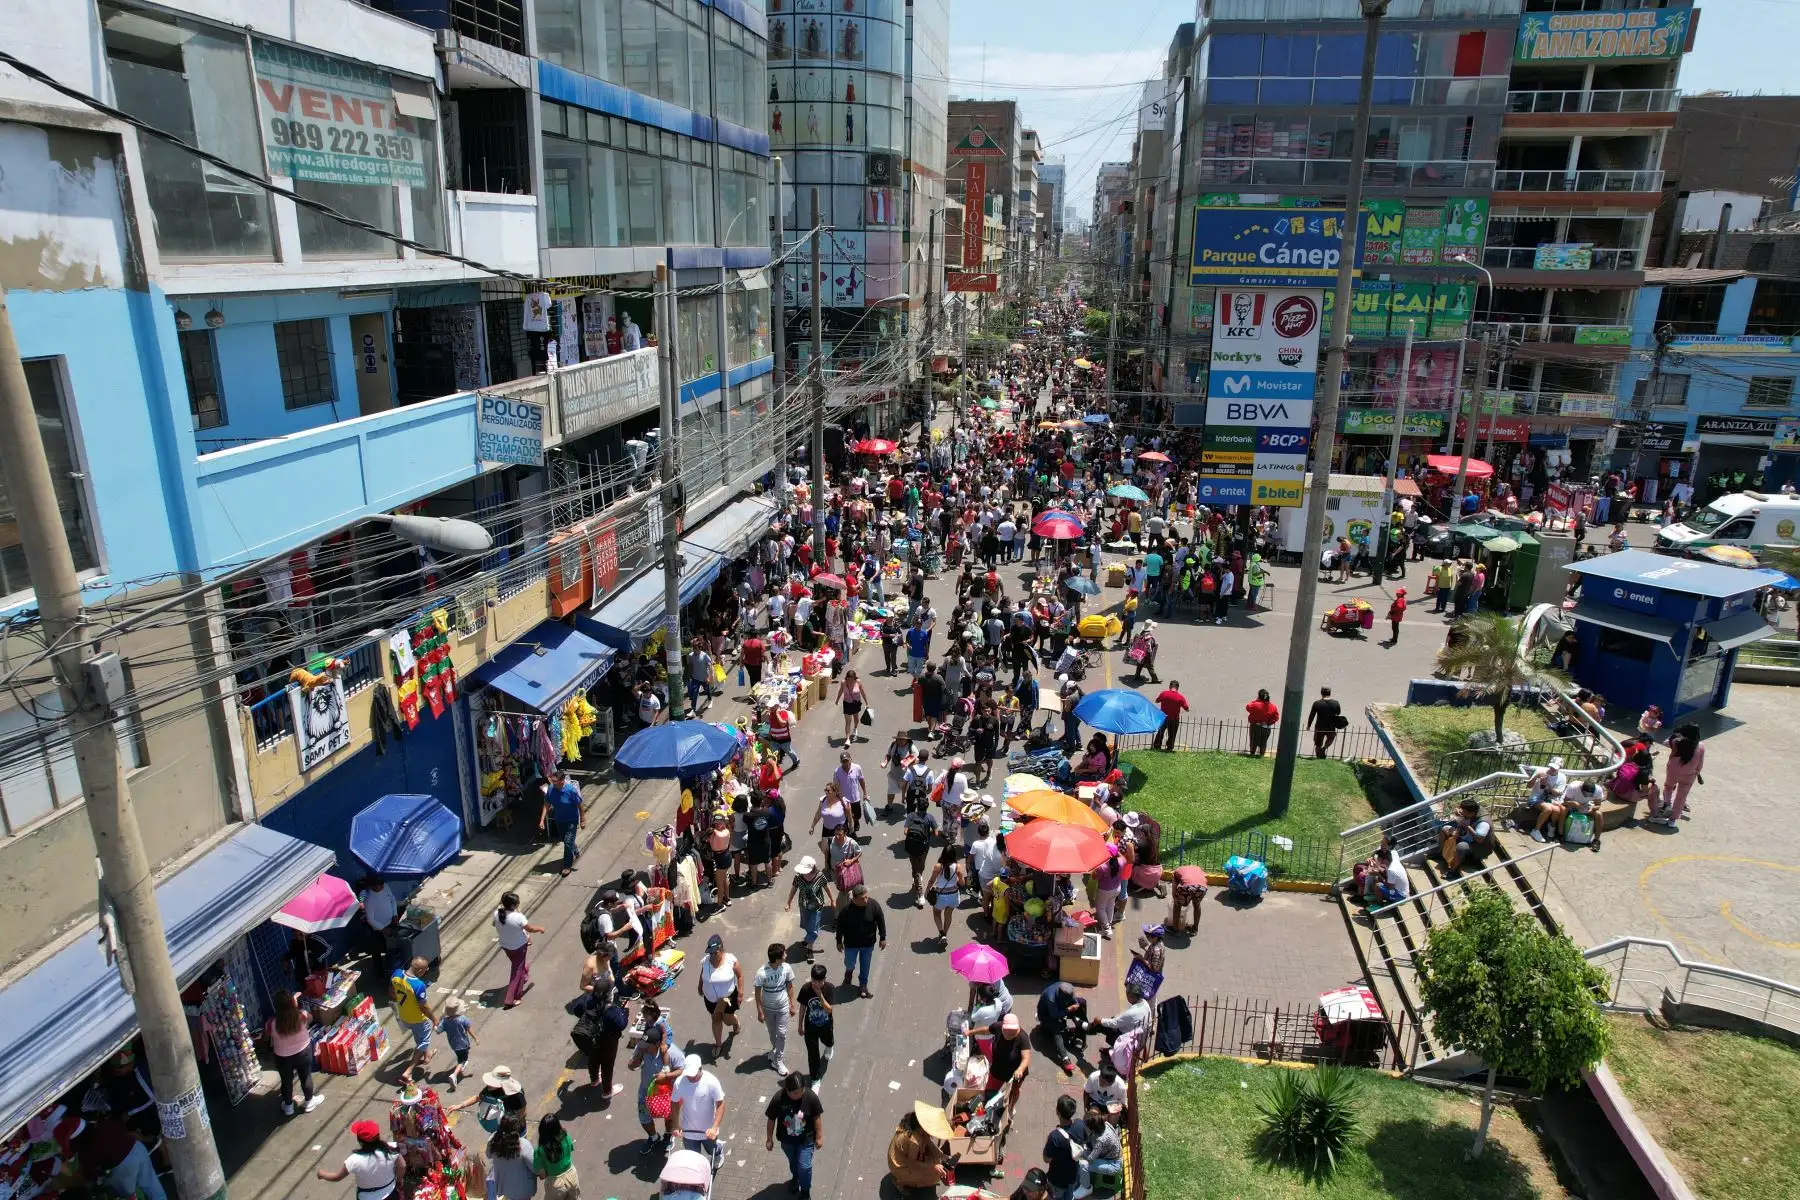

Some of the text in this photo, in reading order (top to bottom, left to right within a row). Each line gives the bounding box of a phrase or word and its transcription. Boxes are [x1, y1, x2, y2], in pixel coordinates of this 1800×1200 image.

[1549, 11, 1657, 31] CRUCERO DEL
[1531, 28, 1669, 59] AMAZONAS
[257, 78, 417, 134] VENTA
[271, 117, 414, 161] 989 222 359
[972, 166, 981, 193] LA
[968, 198, 981, 260] TORRE
[1202, 241, 1341, 270] Parque Cánep
[1239, 276, 1277, 285] Gamarra
[1287, 277, 1307, 286] Perú
[1280, 312, 1307, 326] Pizza
[1284, 320, 1305, 332] Hut
[1226, 327, 1256, 337] KFC
[1737, 335, 1784, 343] CEVICHERIA
[1213, 351, 1262, 365] Norky's
[561, 371, 586, 400] POLOS
[586, 358, 637, 394] PUBLICITARIOS
[1256, 379, 1303, 391] Movistar
[482, 396, 542, 421] POLOS
[1226, 402, 1289, 420] BBVA
[481, 412, 542, 431] PERSONALIZADOS
[1703, 420, 1754, 431] ARANTZA
[480, 432, 542, 448] POLO FOTO
[1215, 434, 1253, 443] Interbank
[1269, 434, 1299, 447] BCP
[479, 441, 542, 458] ESTAMPADOS
[483, 453, 538, 465] EN GENERAL
[1268, 463, 1295, 471] TINKA
[1219, 486, 1247, 497] entel
[1268, 487, 1300, 499] bitel
[596, 545, 618, 566] DESDE
[597, 556, 619, 579] 3X120
[1629, 593, 1655, 605] entel
[304, 743, 327, 767] SAMY
[396, 989, 408, 1007] 7
